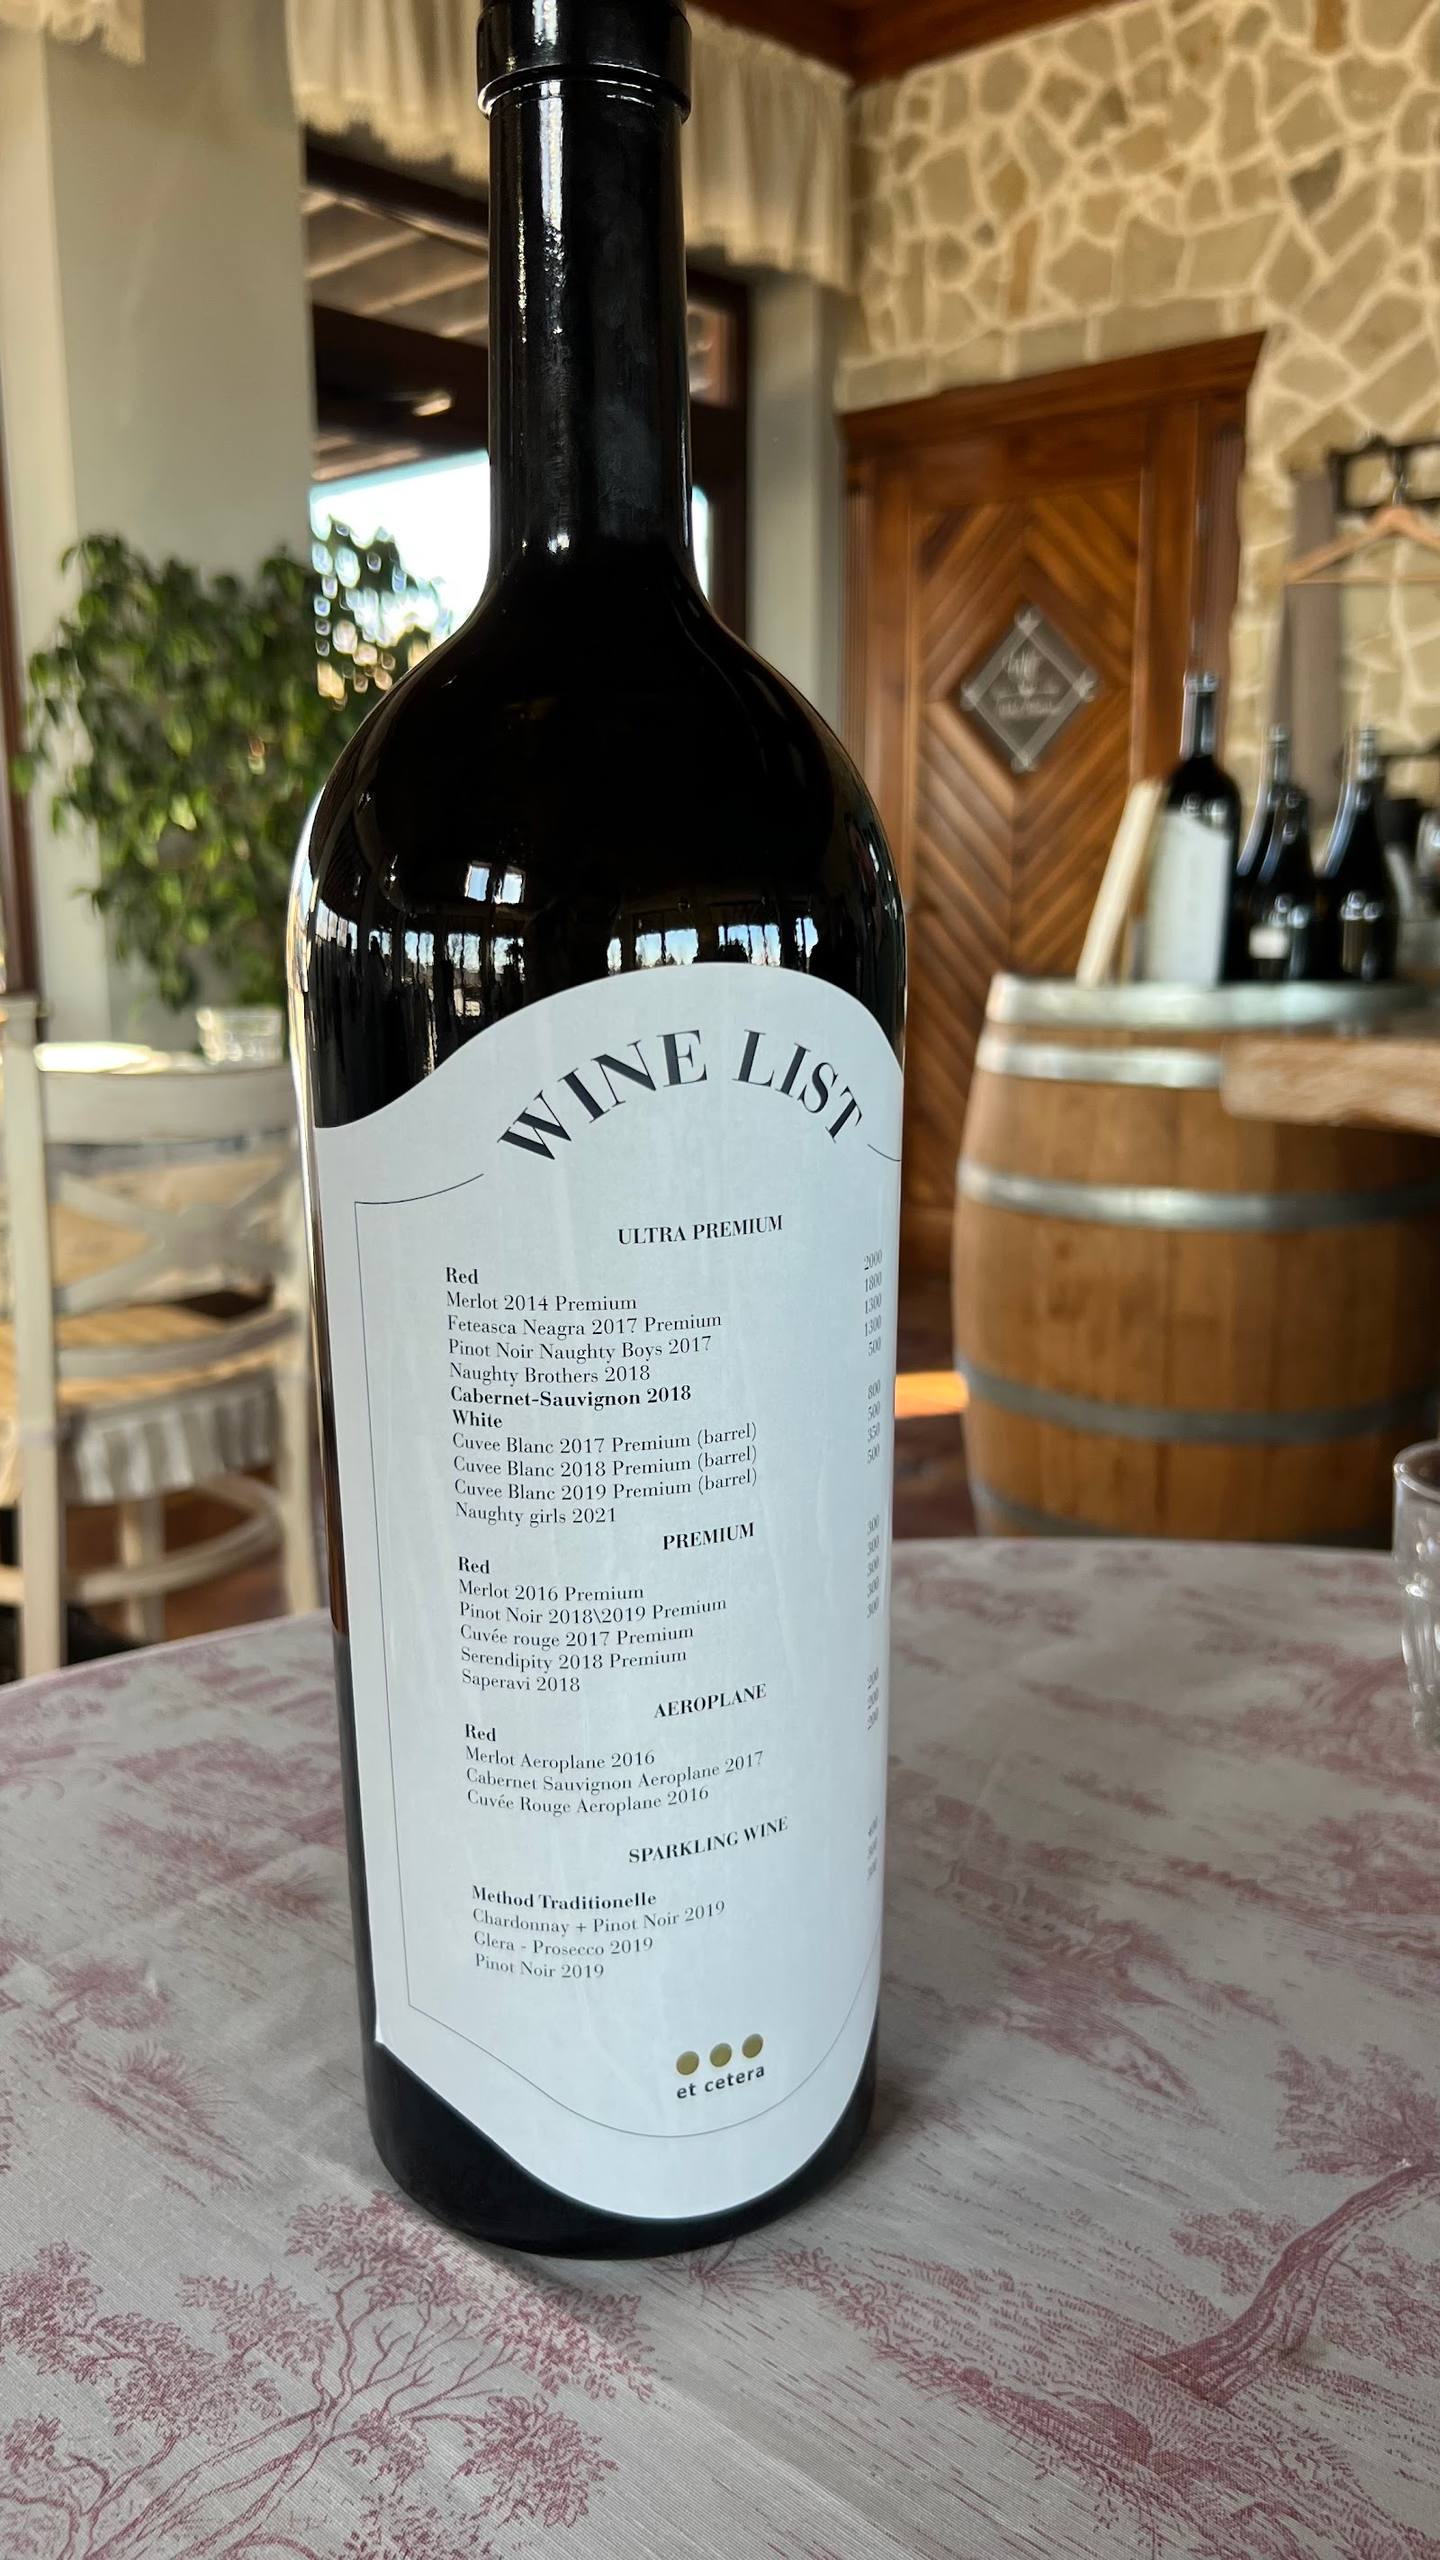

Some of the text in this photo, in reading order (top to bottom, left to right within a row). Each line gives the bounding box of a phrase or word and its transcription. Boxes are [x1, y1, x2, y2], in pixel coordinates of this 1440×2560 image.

[497, 1029, 862, 1160] WINE LIST
[618, 1215, 782, 1245] ULTRA PREMIUM
[864, 1249, 882, 1270] 2000
[446, 1267, 479, 1284] Red
[865, 1271, 882, 1293] 1800
[447, 1291, 637, 1311] Merlot 2014 Premium
[448, 1314, 722, 1341] Feteasca Neagra 2017 Premium
[449, 1336, 711, 1364] Pinot Noir Naughty Boys 2017
[450, 1362, 650, 1387] Naughty Brothers 2018
[451, 1385, 691, 1411] Cabernet-Sauvignon 2018
[453, 1409, 503, 1428] White
[453, 1422, 756, 1454] Cuvee Blanc 2017 Premium (barrel)
[454, 1445, 756, 1477] Cuvee Blanc 2018 Premium (barrel)
[455, 1467, 756, 1500] Cuvee Blanc 2019 Premium (barrel)
[456, 1501, 614, 1528] Naughty girls 2021
[664, 1522, 753, 1550] PREMIUM
[459, 1556, 489, 1574] Red
[459, 1579, 643, 1601] Merlot 2016 Premium
[460, 1600, 726, 1624] Pinot Noir 2018\2019 Premium
[461, 1624, 693, 1651] Cuvée rouge 2017 Premium
[461, 1647, 686, 1674] Serendipity 2018 Premium
[462, 1669, 580, 1692] Saperavi 2018
[654, 1683, 766, 1718] AEROPLANE
[466, 1723, 496, 1742] Red
[466, 1745, 654, 1774] Merlot Aeroplane 2016
[467, 1751, 763, 1796] Cabernet Sauvignon Aeroplane 2017
[468, 1787, 708, 1817] Cuvée Rouge Aeroplane 2016
[629, 1816, 787, 1863] SPARKLING WINE
[473, 1885, 656, 1910] Method Traditionelle
[473, 1901, 724, 1937] Chardonnay + Pinot Noir 2019
[534, 1940, 604, 1955] Prosecco
[610, 1937, 653, 1954] 2019
[476, 1953, 604, 1978] Pinot Noir 2019
[677, 2066, 764, 2099] et cetera
